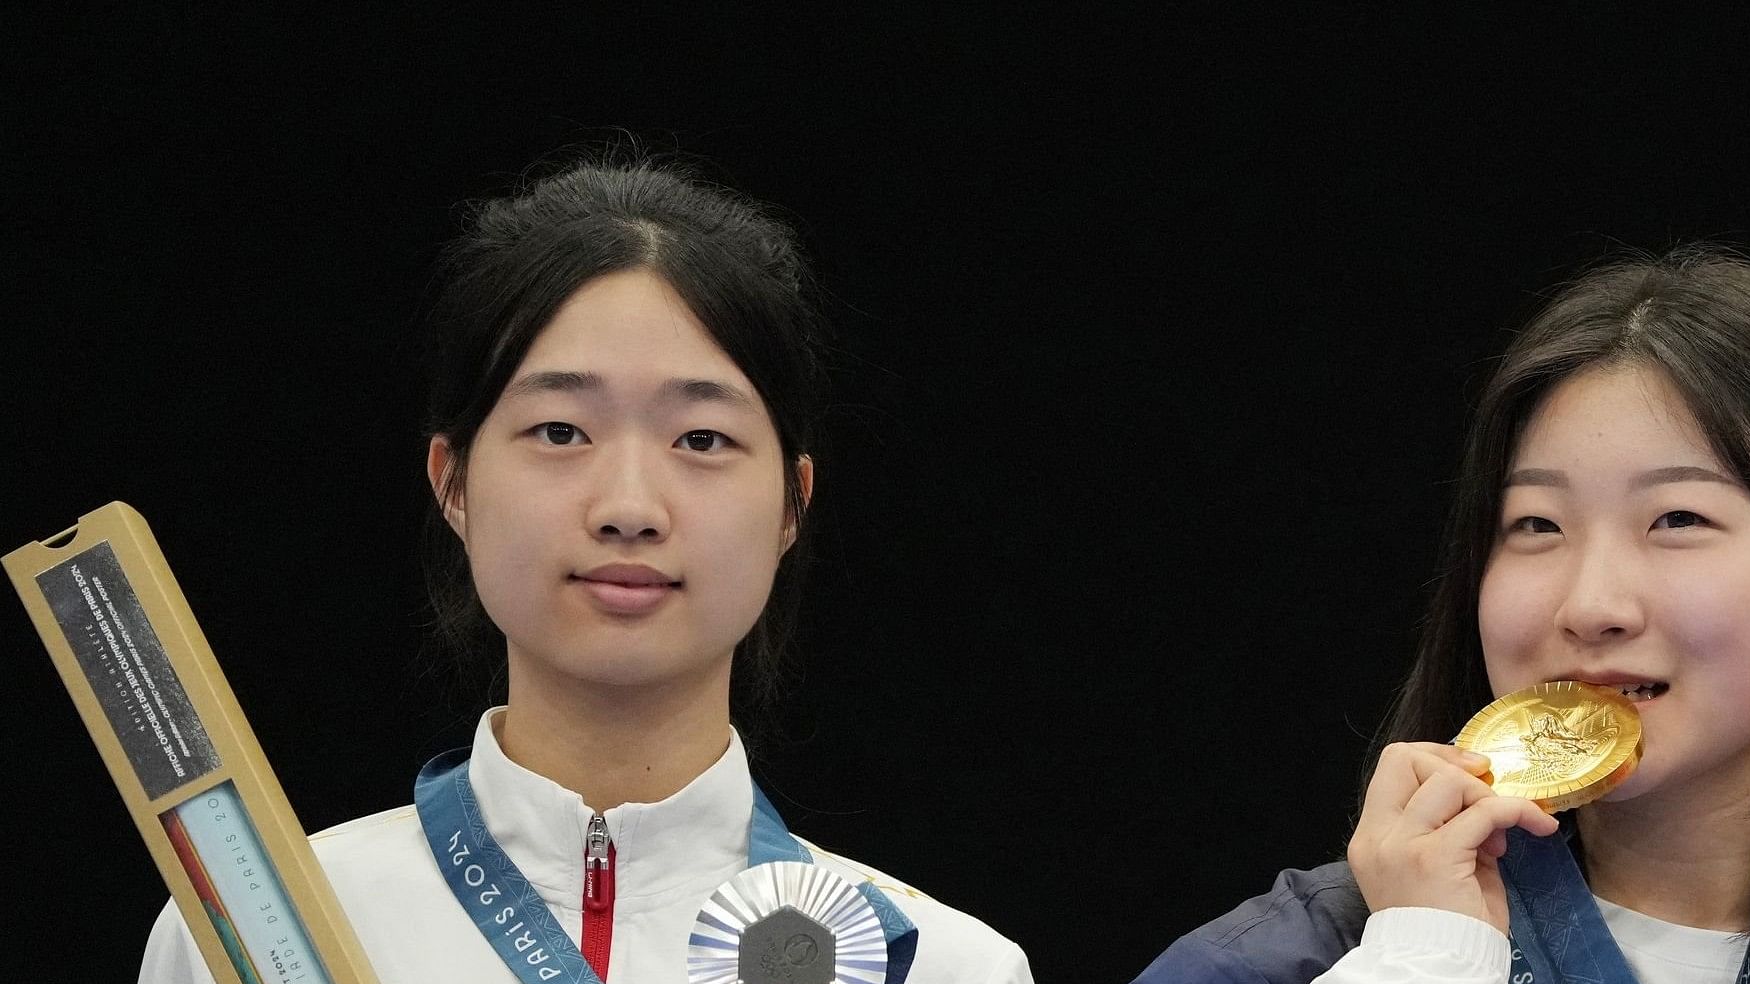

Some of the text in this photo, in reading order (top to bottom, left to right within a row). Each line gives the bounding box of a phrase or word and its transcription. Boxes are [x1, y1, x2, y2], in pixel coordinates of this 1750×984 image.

[70, 565, 184, 776] AFFICHE OFFICIELLE DES JEUX OLYMPIQUES DE PARIS 2024
[225, 833, 260, 889] PARIS
[448, 830, 502, 905] 2024
